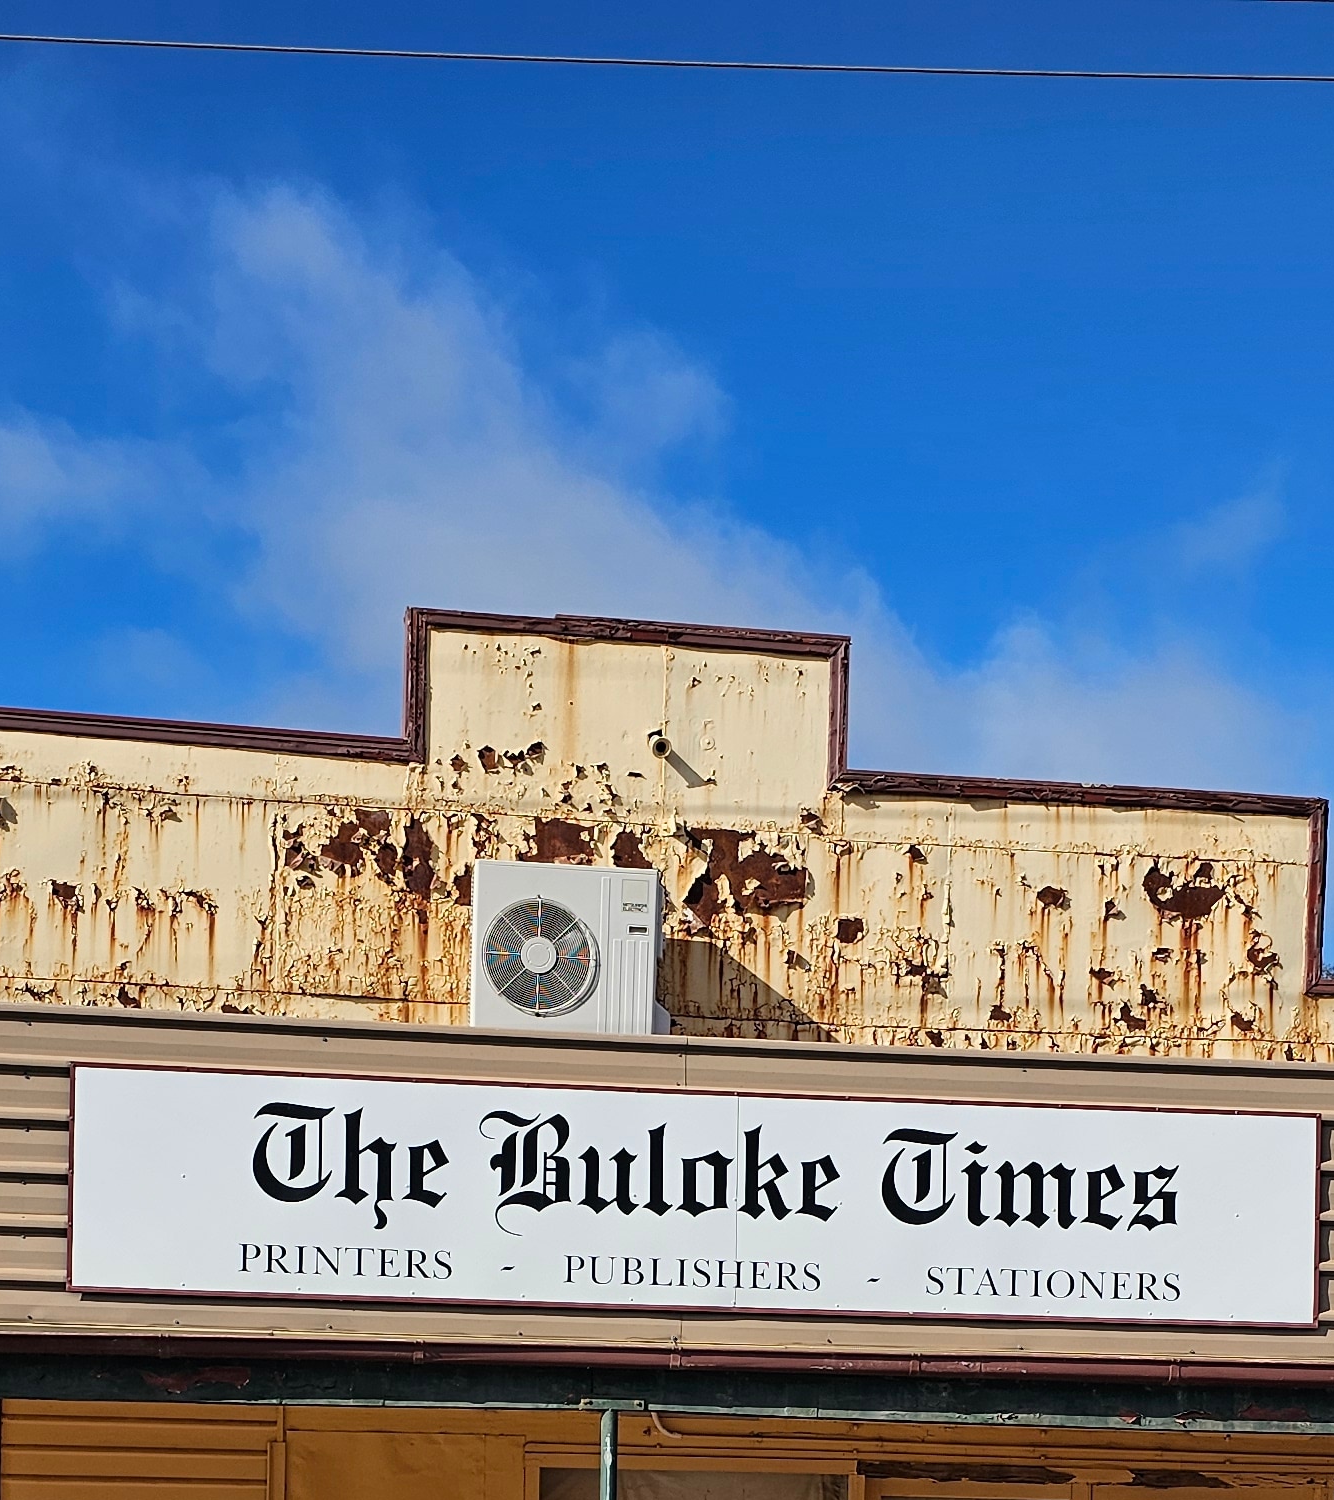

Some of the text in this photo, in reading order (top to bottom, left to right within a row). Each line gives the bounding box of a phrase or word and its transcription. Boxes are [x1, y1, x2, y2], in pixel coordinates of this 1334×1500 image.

[252, 1102, 1180, 1237] The Buloke Times
[238, 1243, 453, 1280] PRINTERS
[563, 1254, 821, 1292] PUBLISHERS
[925, 1266, 1181, 1302] STATIONERS
